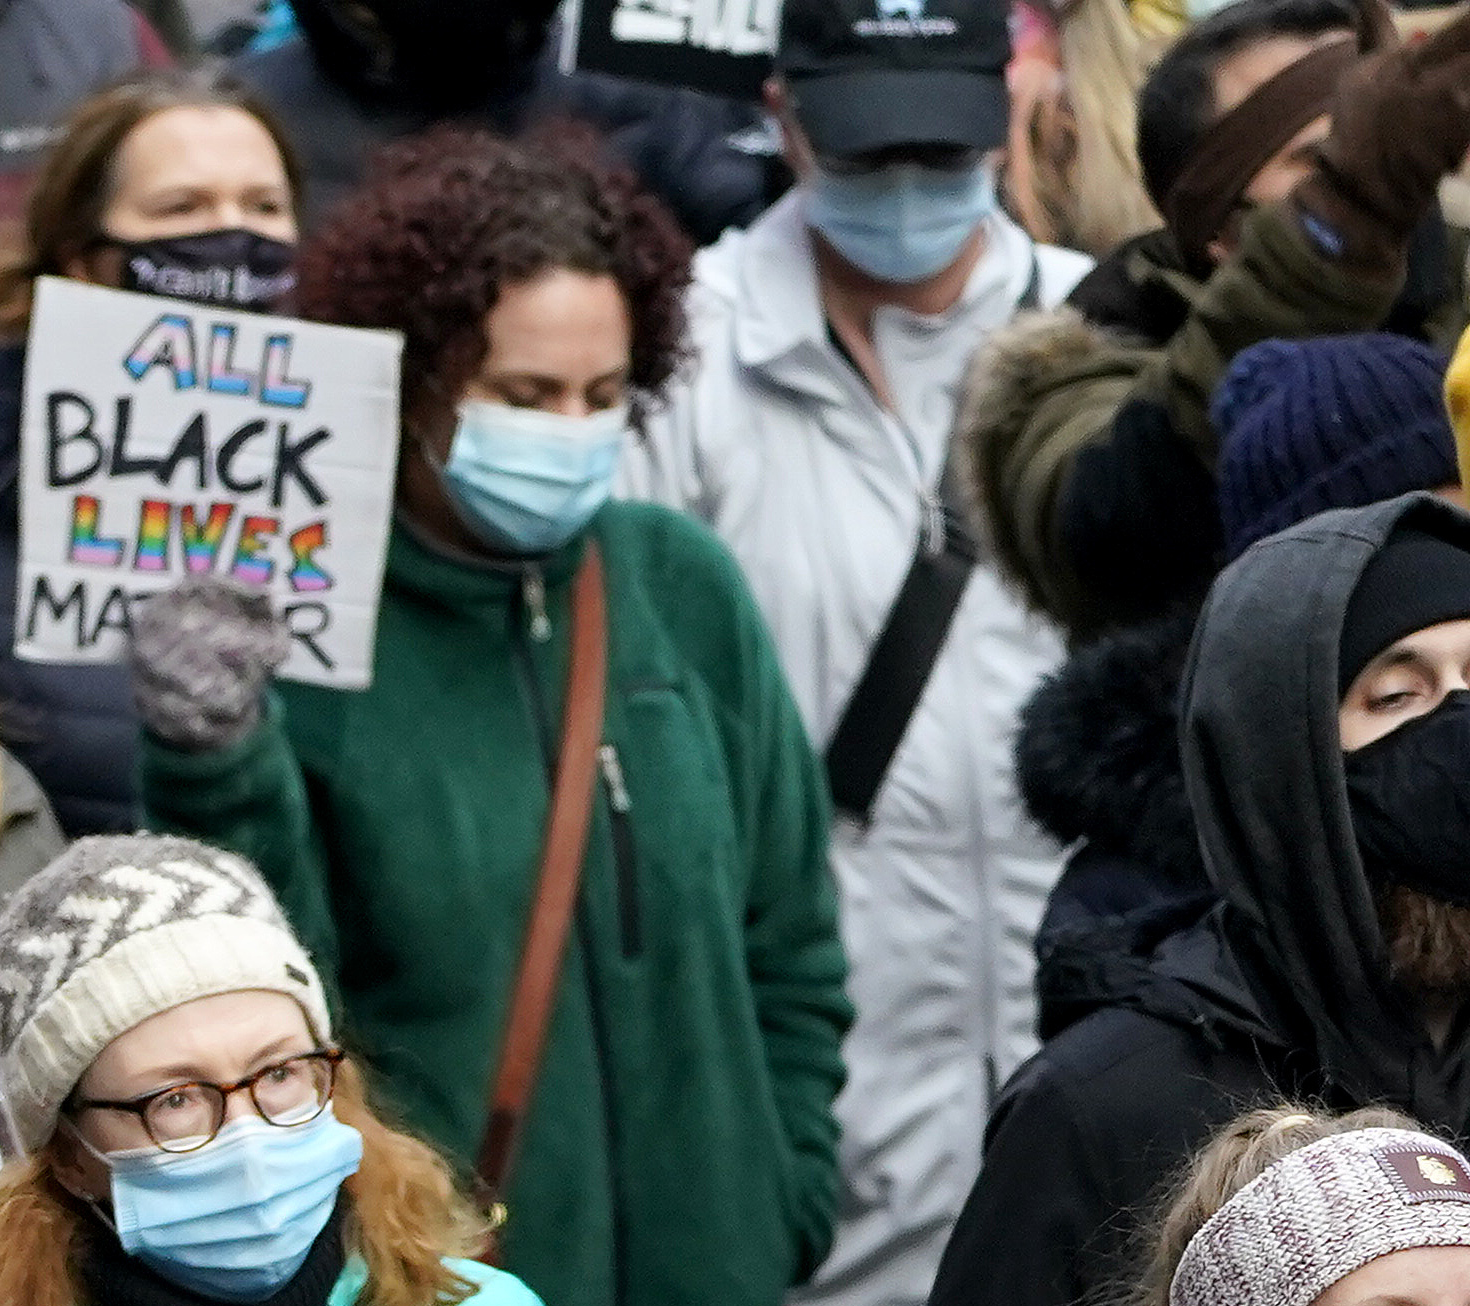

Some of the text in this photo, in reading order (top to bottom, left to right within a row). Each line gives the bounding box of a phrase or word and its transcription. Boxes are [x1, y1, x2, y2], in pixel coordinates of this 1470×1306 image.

[123, 312, 312, 410] ALL
[45, 390, 333, 508] BLACK
[68, 494, 334, 593] LIVES
[23, 574, 336, 672] MAR
